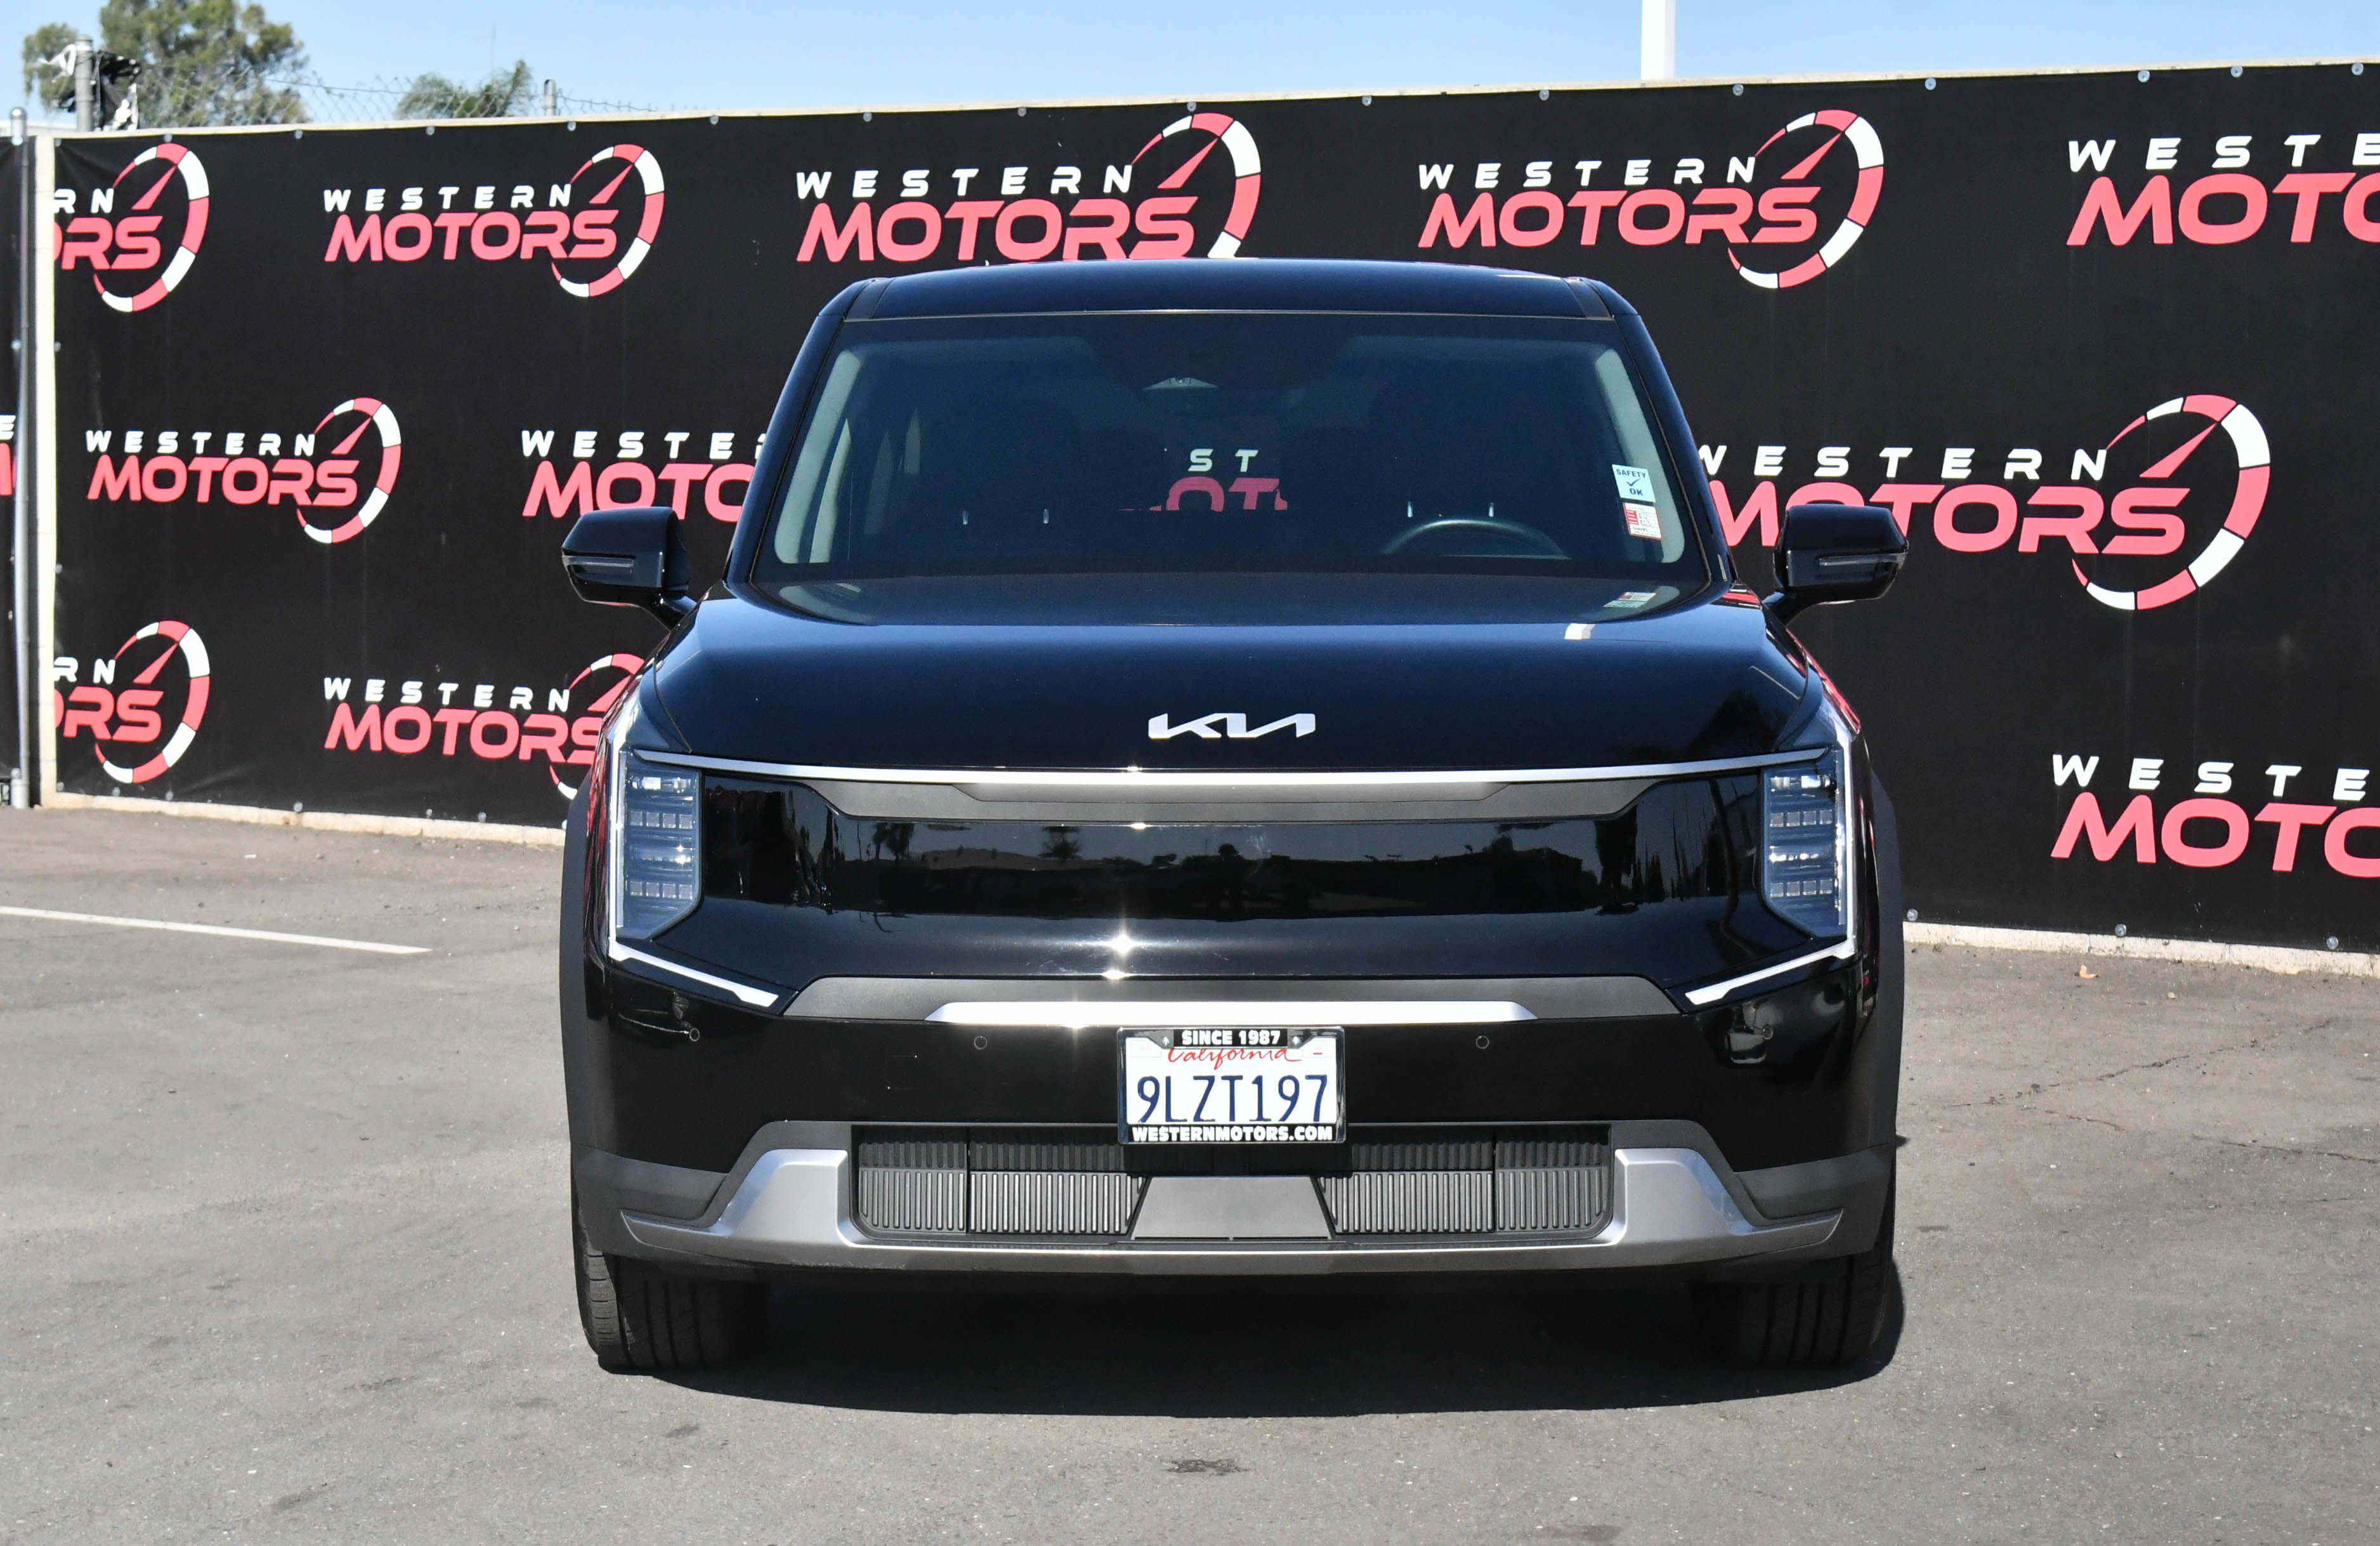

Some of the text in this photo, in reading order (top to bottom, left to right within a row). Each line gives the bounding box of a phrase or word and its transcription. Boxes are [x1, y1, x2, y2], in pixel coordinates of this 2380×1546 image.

[796, 164, 1133, 199] WESTERN
[1418, 156, 1756, 190] WESTERN
[324, 183, 572, 213] WESTERN
[796, 196, 1199, 262] MOTORS
[1418, 186, 1821, 249] MOTORS
[55, 215, 164, 270] RS
[324, 209, 619, 263] MOTORS
[86, 430, 316, 457] WESTERN
[87, 454, 360, 507] MOTORS
[1616, 468, 1645, 478] SAFETY
[1629, 488, 1644, 496] OK
[324, 677, 571, 712] WESTERN
[55, 686, 164, 744] RS
[1148, 712, 1316, 739] KIA
[2052, 754, 2370, 801] WESTE
[1182, 1030, 1281, 1045] SINCE 1987
[1167, 1048, 1302, 1070] California
[1137, 1074, 1328, 1123] 9LZT197
[1132, 1125, 1332, 1142] WESTERNMOTORS.COM
